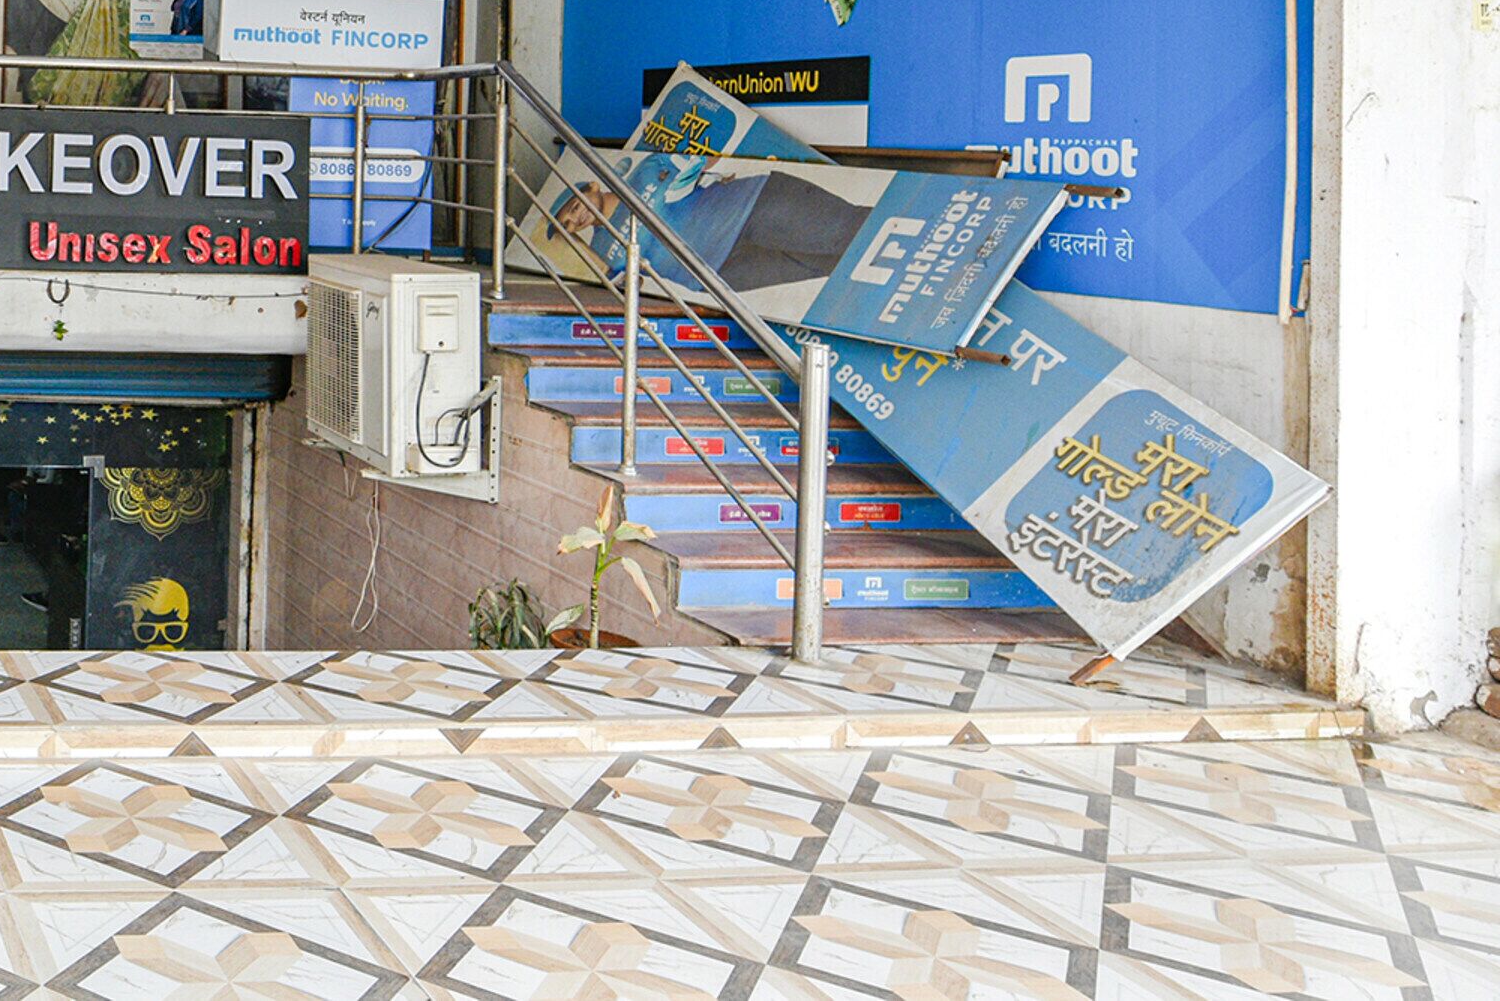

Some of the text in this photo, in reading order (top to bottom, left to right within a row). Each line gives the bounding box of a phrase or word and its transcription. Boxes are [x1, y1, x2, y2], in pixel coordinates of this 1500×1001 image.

[233, 26, 429, 49] muthoot FINCORP
[314, 91, 339, 106] No
[680, 104, 711, 140] मेरा
[368, 164, 412, 177] 80869
[28, 219, 302, 268] Unisex Salon
[878, 190, 978, 324] muthoot
[920, 196, 992, 297] FINCORP
[1049, 227, 1135, 262] बदलनी हो
[1010, 328, 1067, 386] पर
[835, 364, 896, 420] 80869
[1136, 434, 1210, 494] मेरा
[1055, 434, 1240, 552] गोल्ड लोन
[1068, 492, 1139, 549] मेरा
[1008, 510, 1136, 598] इंटरेस्ट
